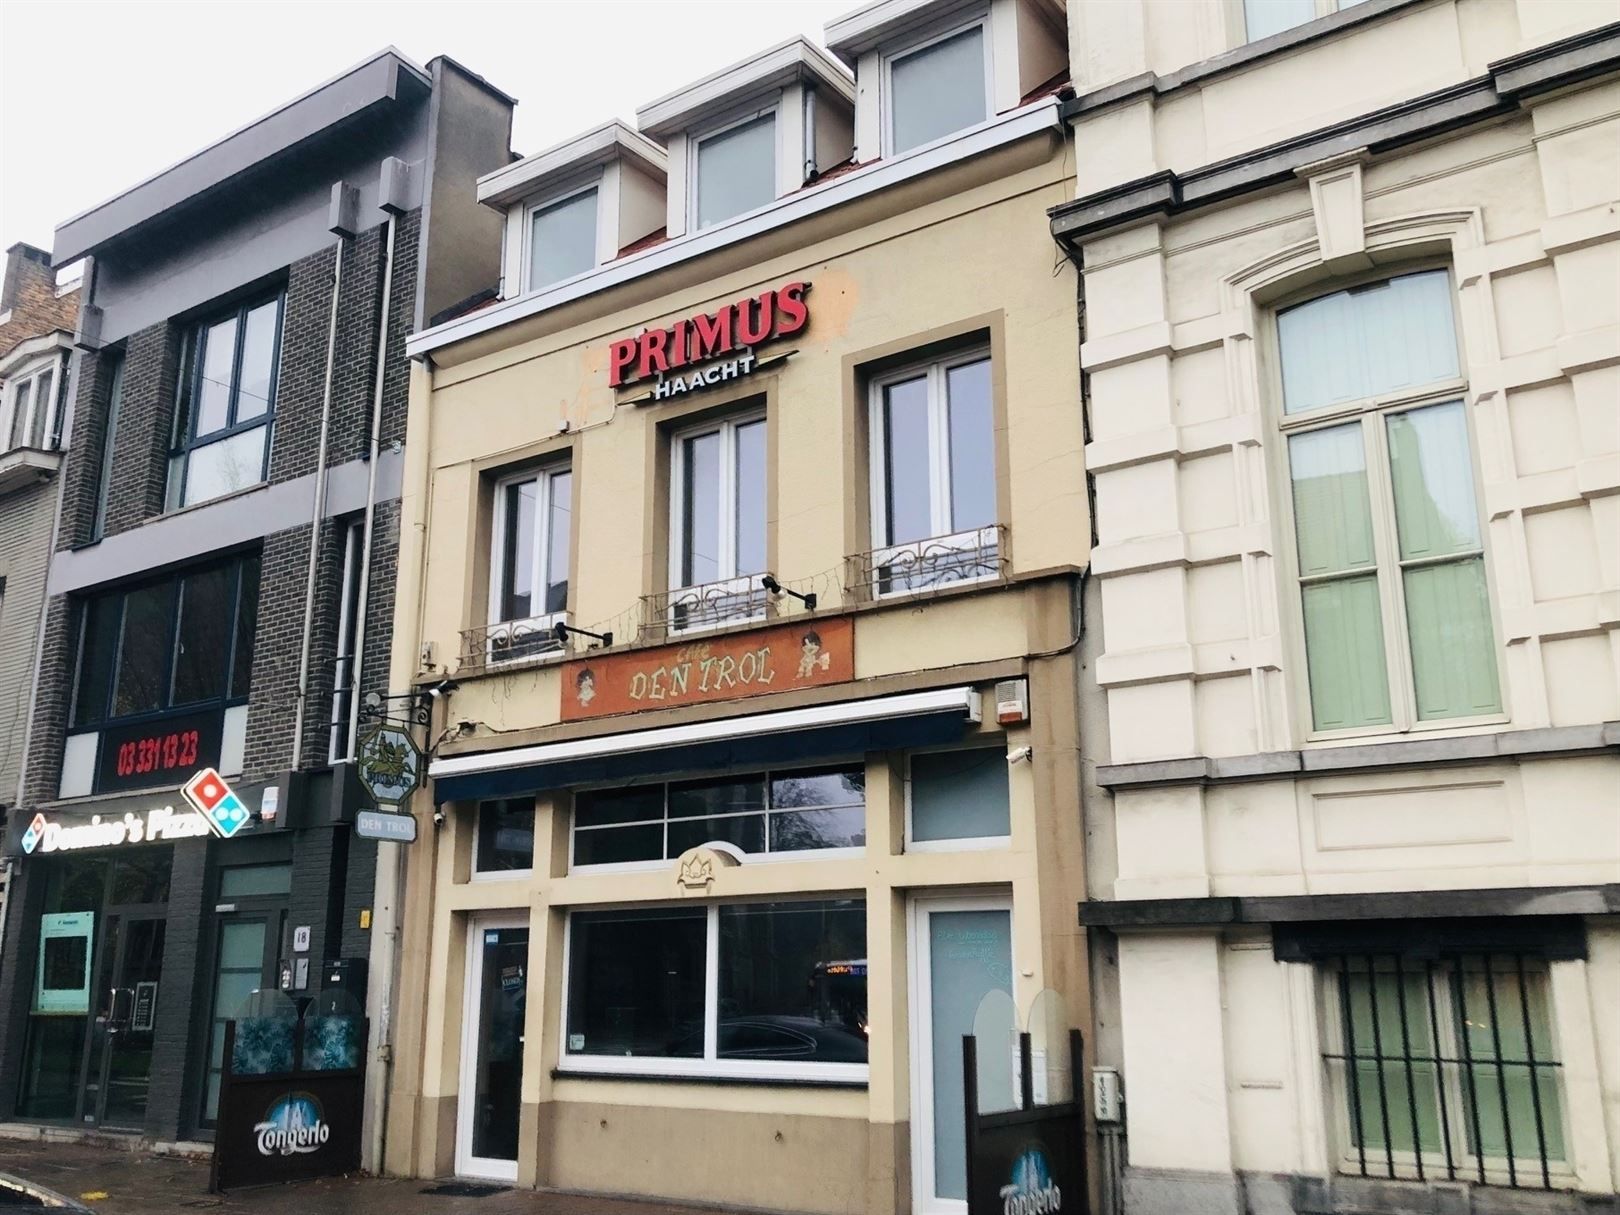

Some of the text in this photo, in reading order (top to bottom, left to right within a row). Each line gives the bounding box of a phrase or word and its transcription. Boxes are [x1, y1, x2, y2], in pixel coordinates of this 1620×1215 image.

[608, 282, 812, 389] PRIMUS
[655, 354, 755, 400] HAACHT
[629, 647, 774, 700] DEN TROL
[118, 731, 198, 776] 03 331 13 23
[42, 806, 211, 853] Domino's Pizza
[360, 818, 382, 831] DEN
[297, 932, 307, 943] 18
[253, 1119, 329, 1156] Tongerlo
